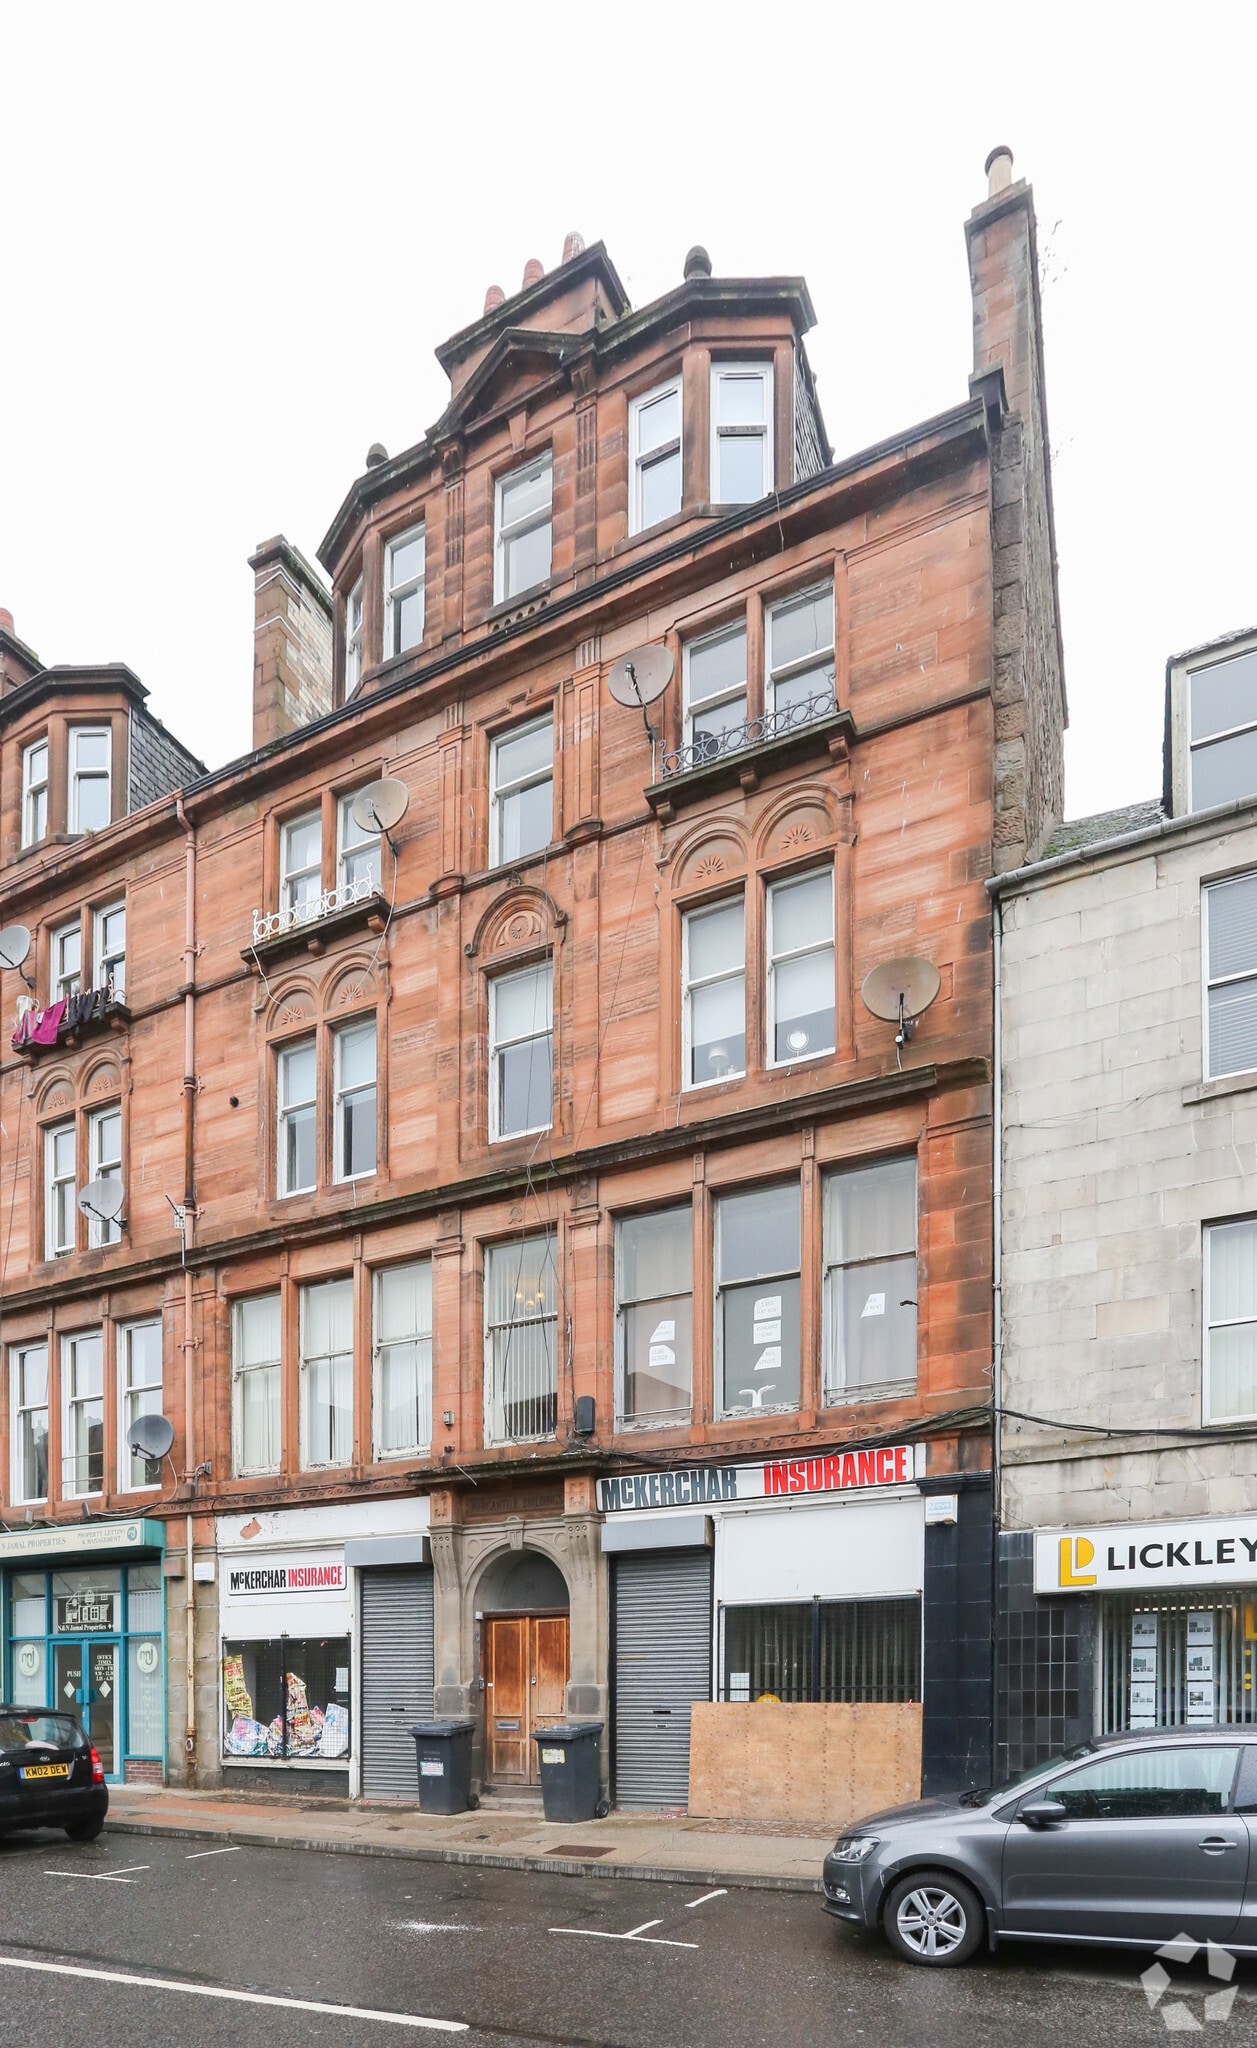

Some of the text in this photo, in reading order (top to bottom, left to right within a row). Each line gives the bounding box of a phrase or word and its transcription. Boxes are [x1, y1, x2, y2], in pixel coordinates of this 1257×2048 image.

[764, 1447, 907, 1495] INSURANCE
[78, 1528, 126, 1539] PROPERTY LETTING
[7, 1540, 26, 1550] JAMAL
[28, 1537, 66, 1549] PROPERTIES
[87, 1536, 121, 1545] MANAGEMENT
[1107, 1537, 1257, 1571] LICKLEY
[288, 1566, 343, 1587] INSURANCE
[84, 1623, 107, 1632] Properties
[25, 1765, 67, 1777] KM02 DEW
